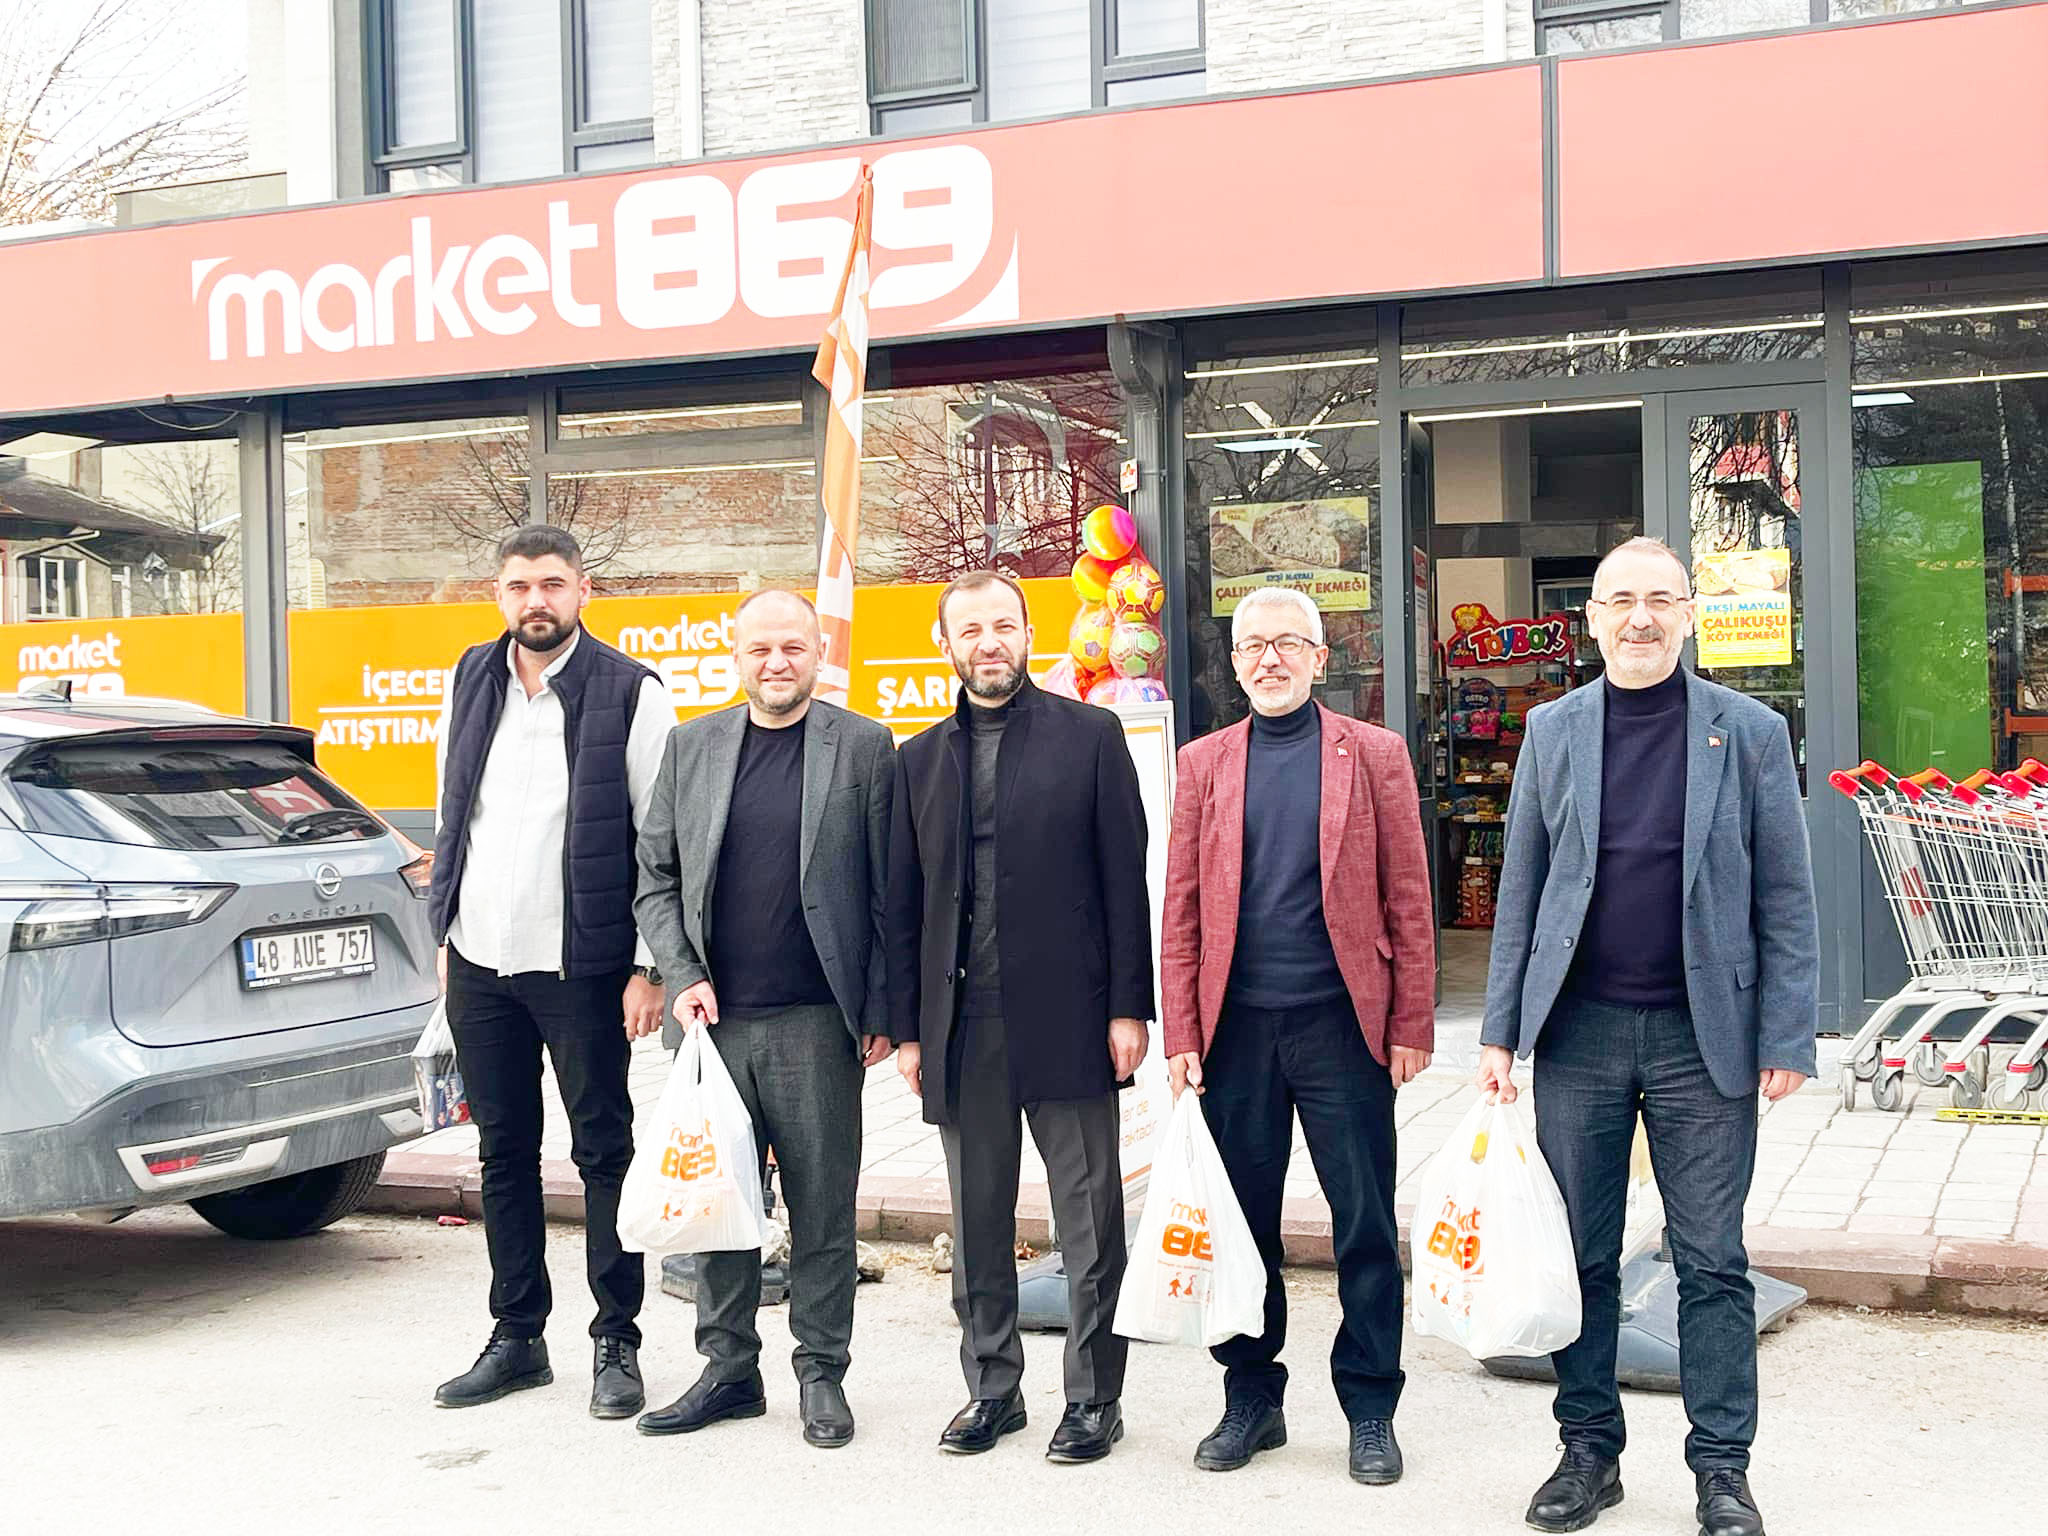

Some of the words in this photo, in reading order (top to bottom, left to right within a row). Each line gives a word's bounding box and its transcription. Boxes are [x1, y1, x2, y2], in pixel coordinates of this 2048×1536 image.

[207, 202, 601, 361] market
[614, 143, 993, 328] 869
[1315, 577, 1367, 594] EKMEĞİ
[1703, 615, 1787, 631] ÇALIKUŞU
[1706, 603, 1733, 614] EKŞİ
[1738, 601, 1785, 611] MAYALI
[18, 632, 122, 672] market
[619, 612, 735, 653] market
[1706, 630, 1733, 642] KÖY
[1737, 628, 1785, 641] EKMEĞİ
[640, 656, 740, 706] 69
[258, 940, 279, 973] 48
[293, 934, 327, 969] AUE
[337, 929, 369, 963] 757
